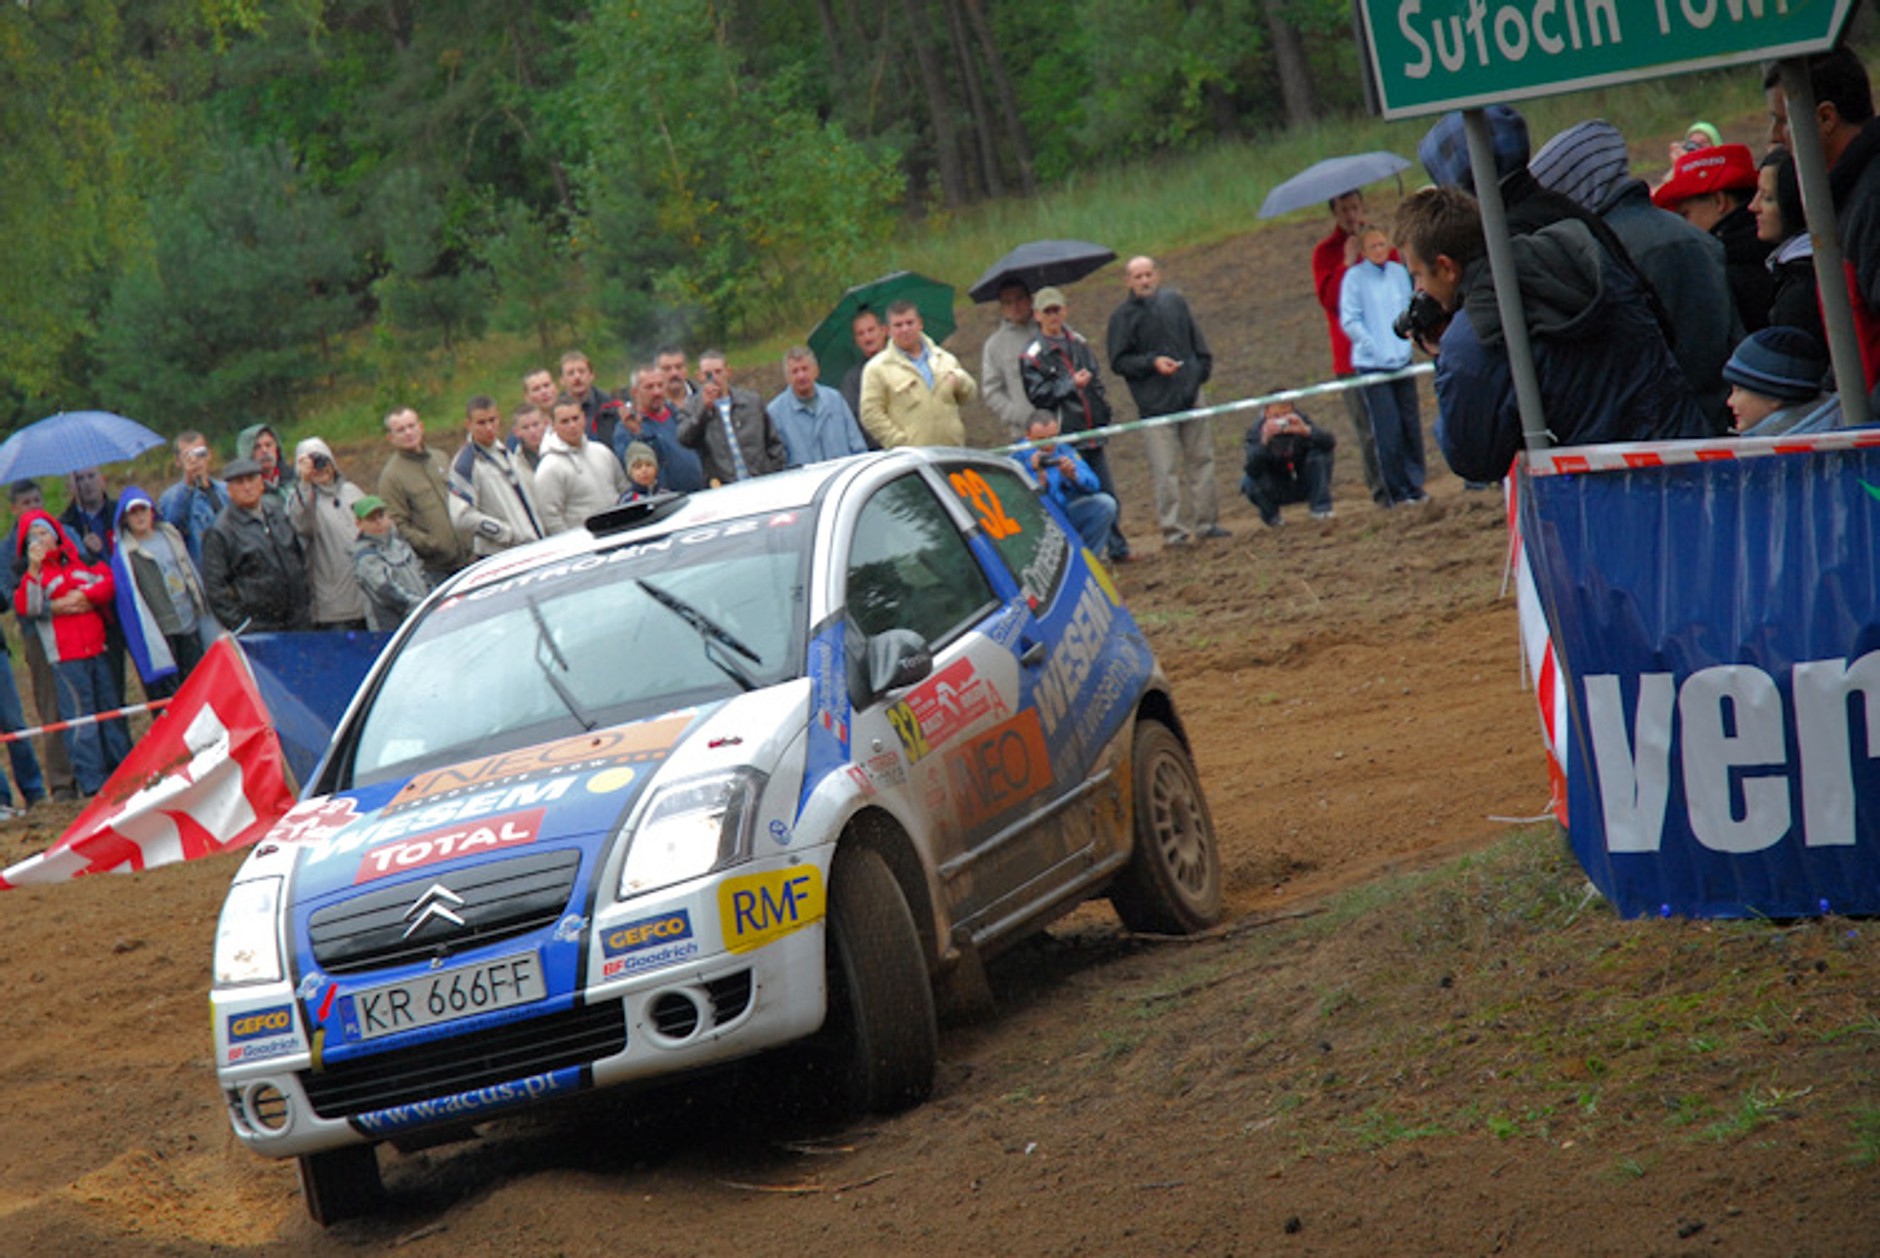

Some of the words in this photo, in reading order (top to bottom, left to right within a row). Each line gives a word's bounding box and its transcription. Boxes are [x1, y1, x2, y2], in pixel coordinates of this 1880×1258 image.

[949, 468, 1023, 540] 32
[1032, 574, 1114, 736] WESEM
[421, 732, 625, 794] NEO
[886, 700, 930, 765] 32
[954, 729, 1032, 818] NEO
[307, 775, 579, 866] WESEM
[371, 822, 530, 871] TOTAL
[608, 917, 686, 948] GEFCO
[733, 876, 810, 935] RMF
[603, 942, 699, 977] BFGoodrich
[232, 1010, 290, 1036] GEFCO
[361, 988, 415, 1033] KR
[427, 958, 532, 1017] 666FF
